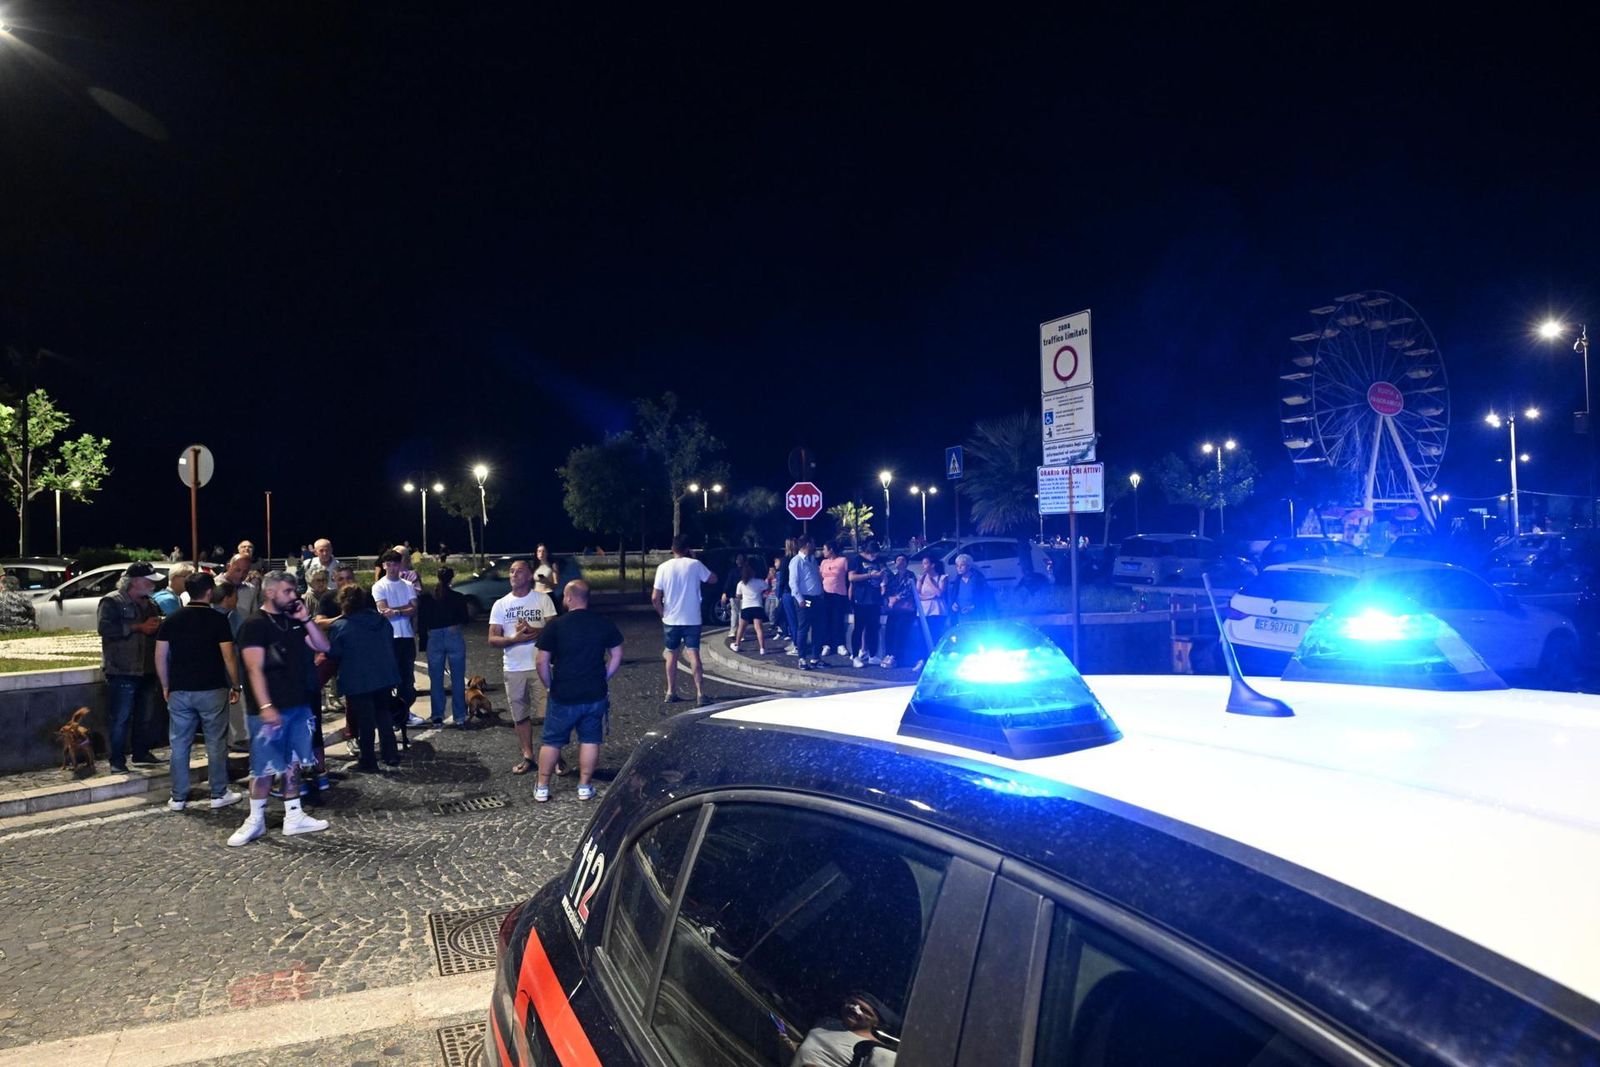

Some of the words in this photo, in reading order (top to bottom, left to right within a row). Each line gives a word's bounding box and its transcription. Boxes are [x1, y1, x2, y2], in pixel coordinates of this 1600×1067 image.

[1058, 323, 1071, 332] zona
[1043, 335, 1064, 346] traffico
[1064, 328, 1088, 341] limitato
[1061, 467, 1082, 475] VACHI
[1084, 466, 1101, 474] ATTIVI
[789, 494, 819, 508] STOP
[569, 836, 605, 925] 112
